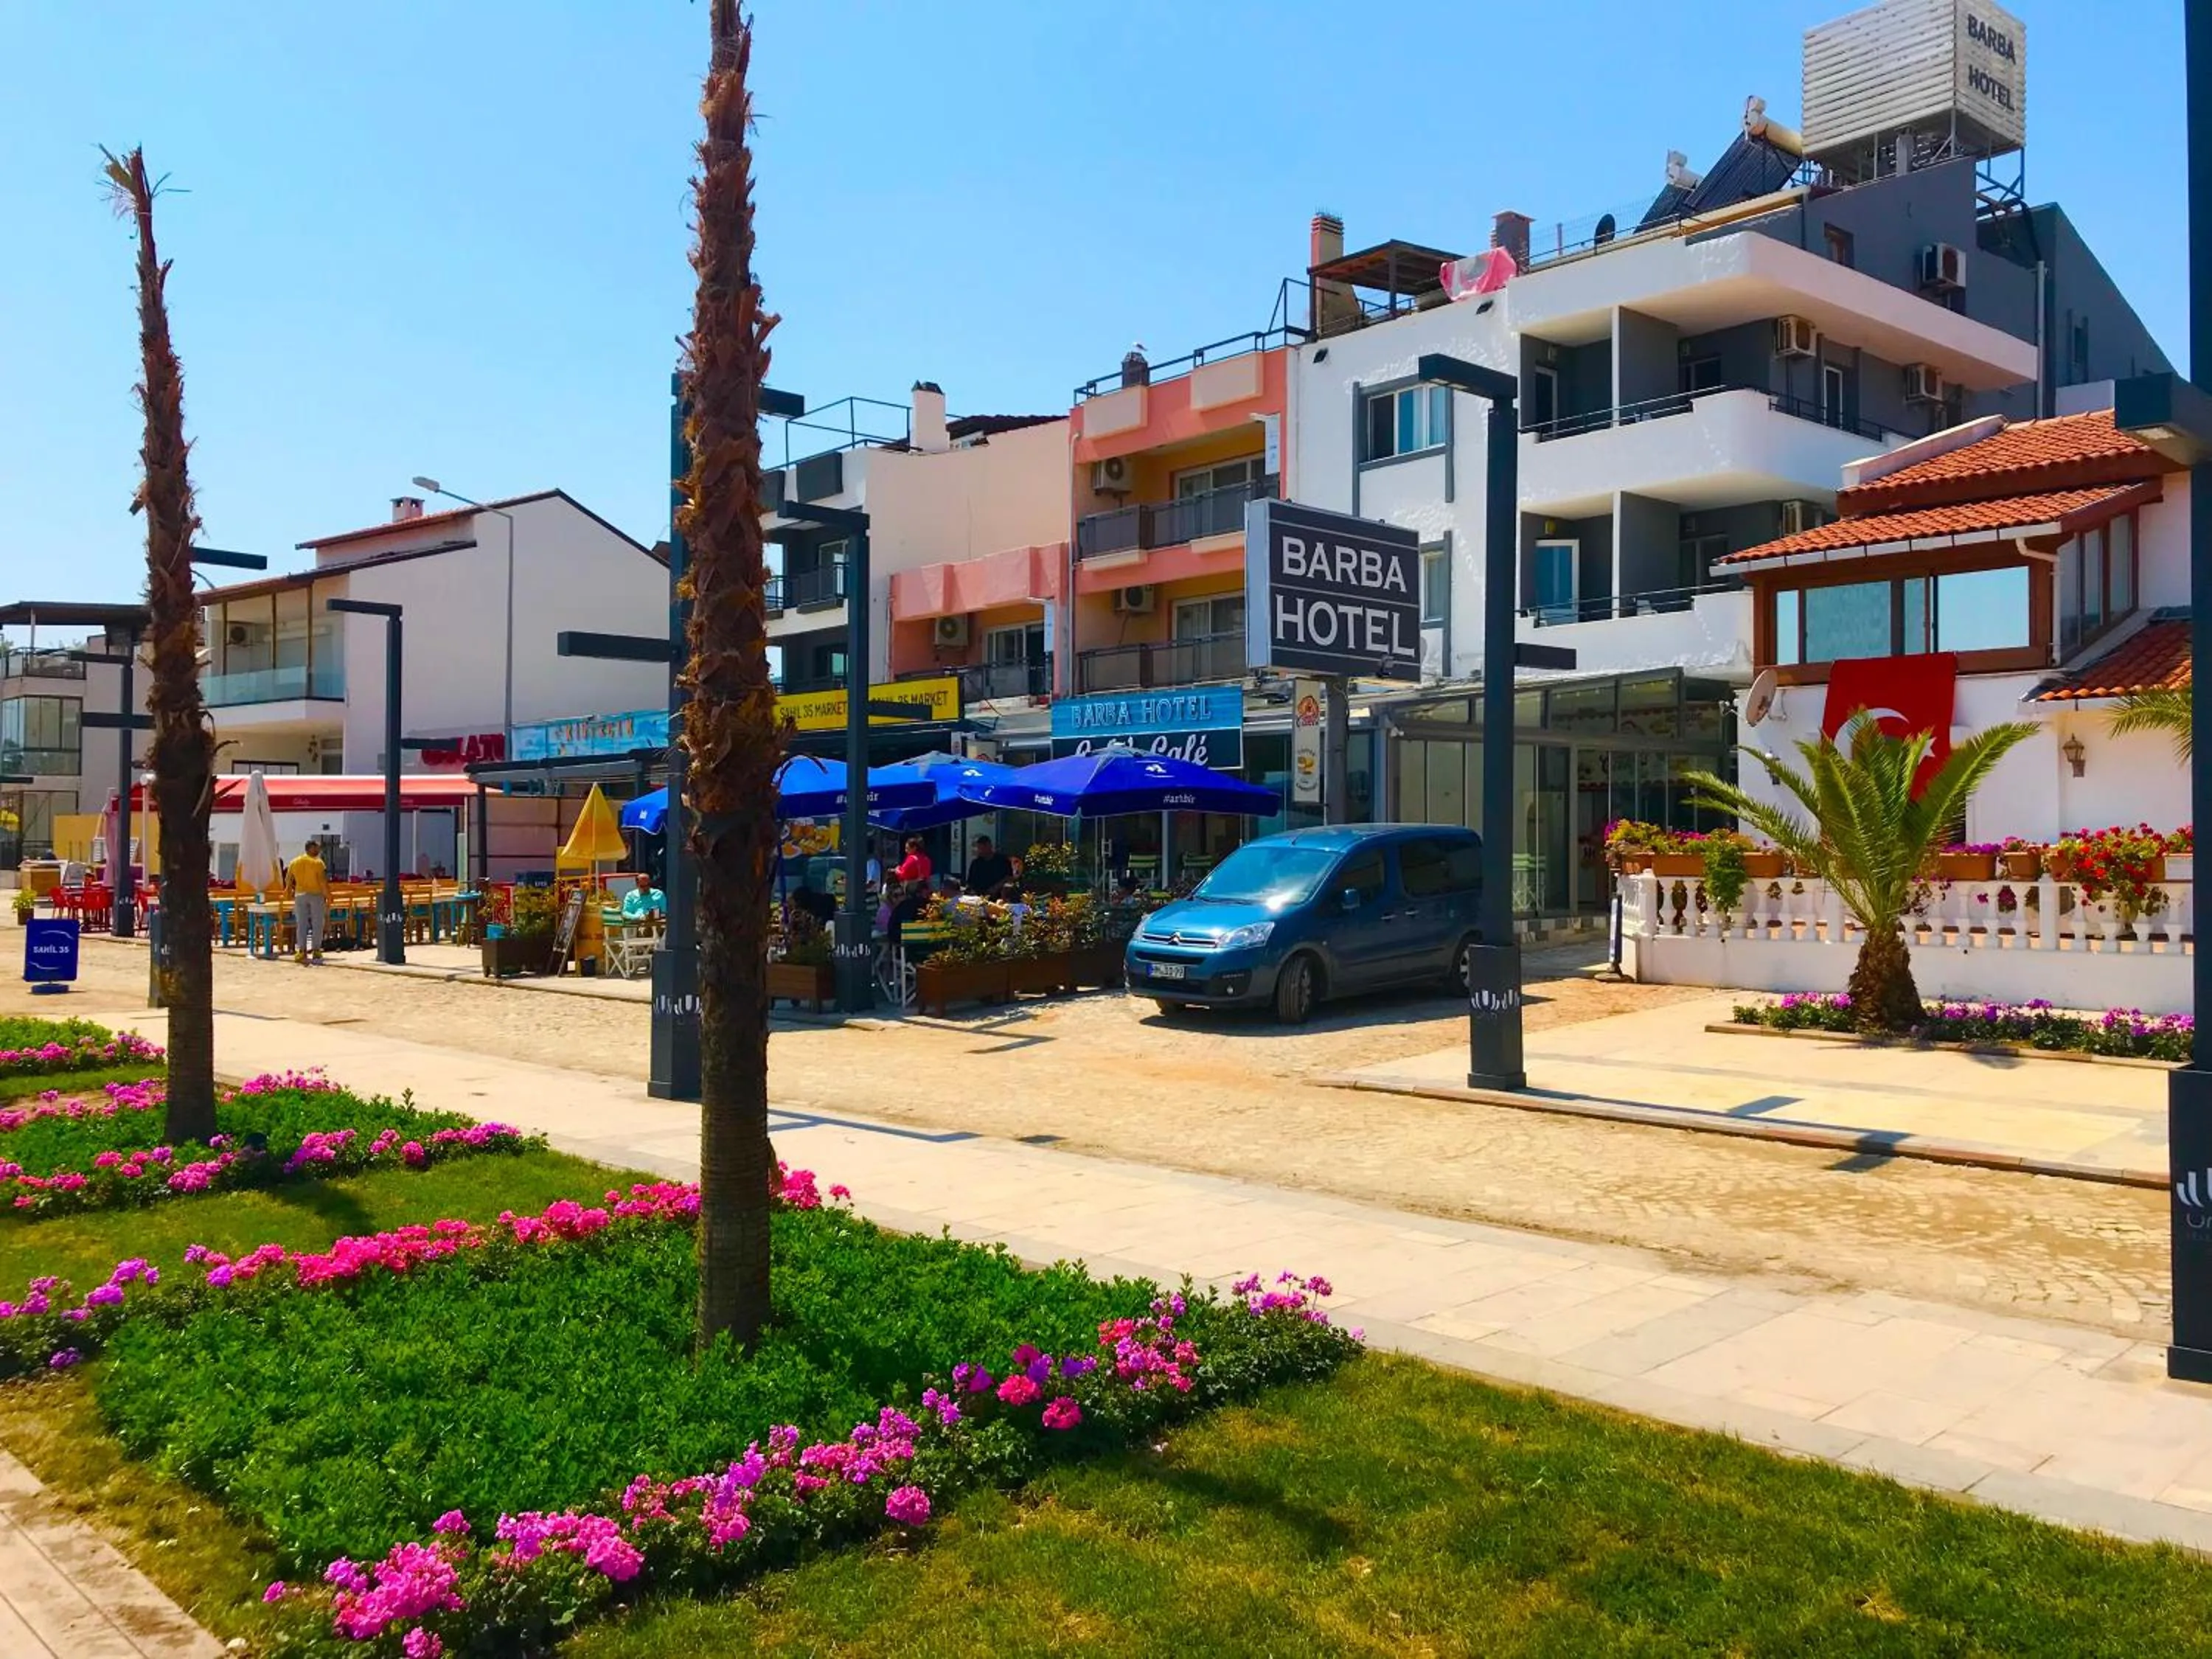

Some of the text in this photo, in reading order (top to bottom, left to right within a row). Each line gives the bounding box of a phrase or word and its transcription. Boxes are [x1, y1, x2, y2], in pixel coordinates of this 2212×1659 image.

[1967, 13, 2017, 65] BARBA
[1968, 64, 2015, 112] HOTEL
[1281, 536, 1408, 593] BARBA
[1275, 594, 1415, 658] HOTEL
[1071, 695, 1211, 728] BARBA HOTEL
